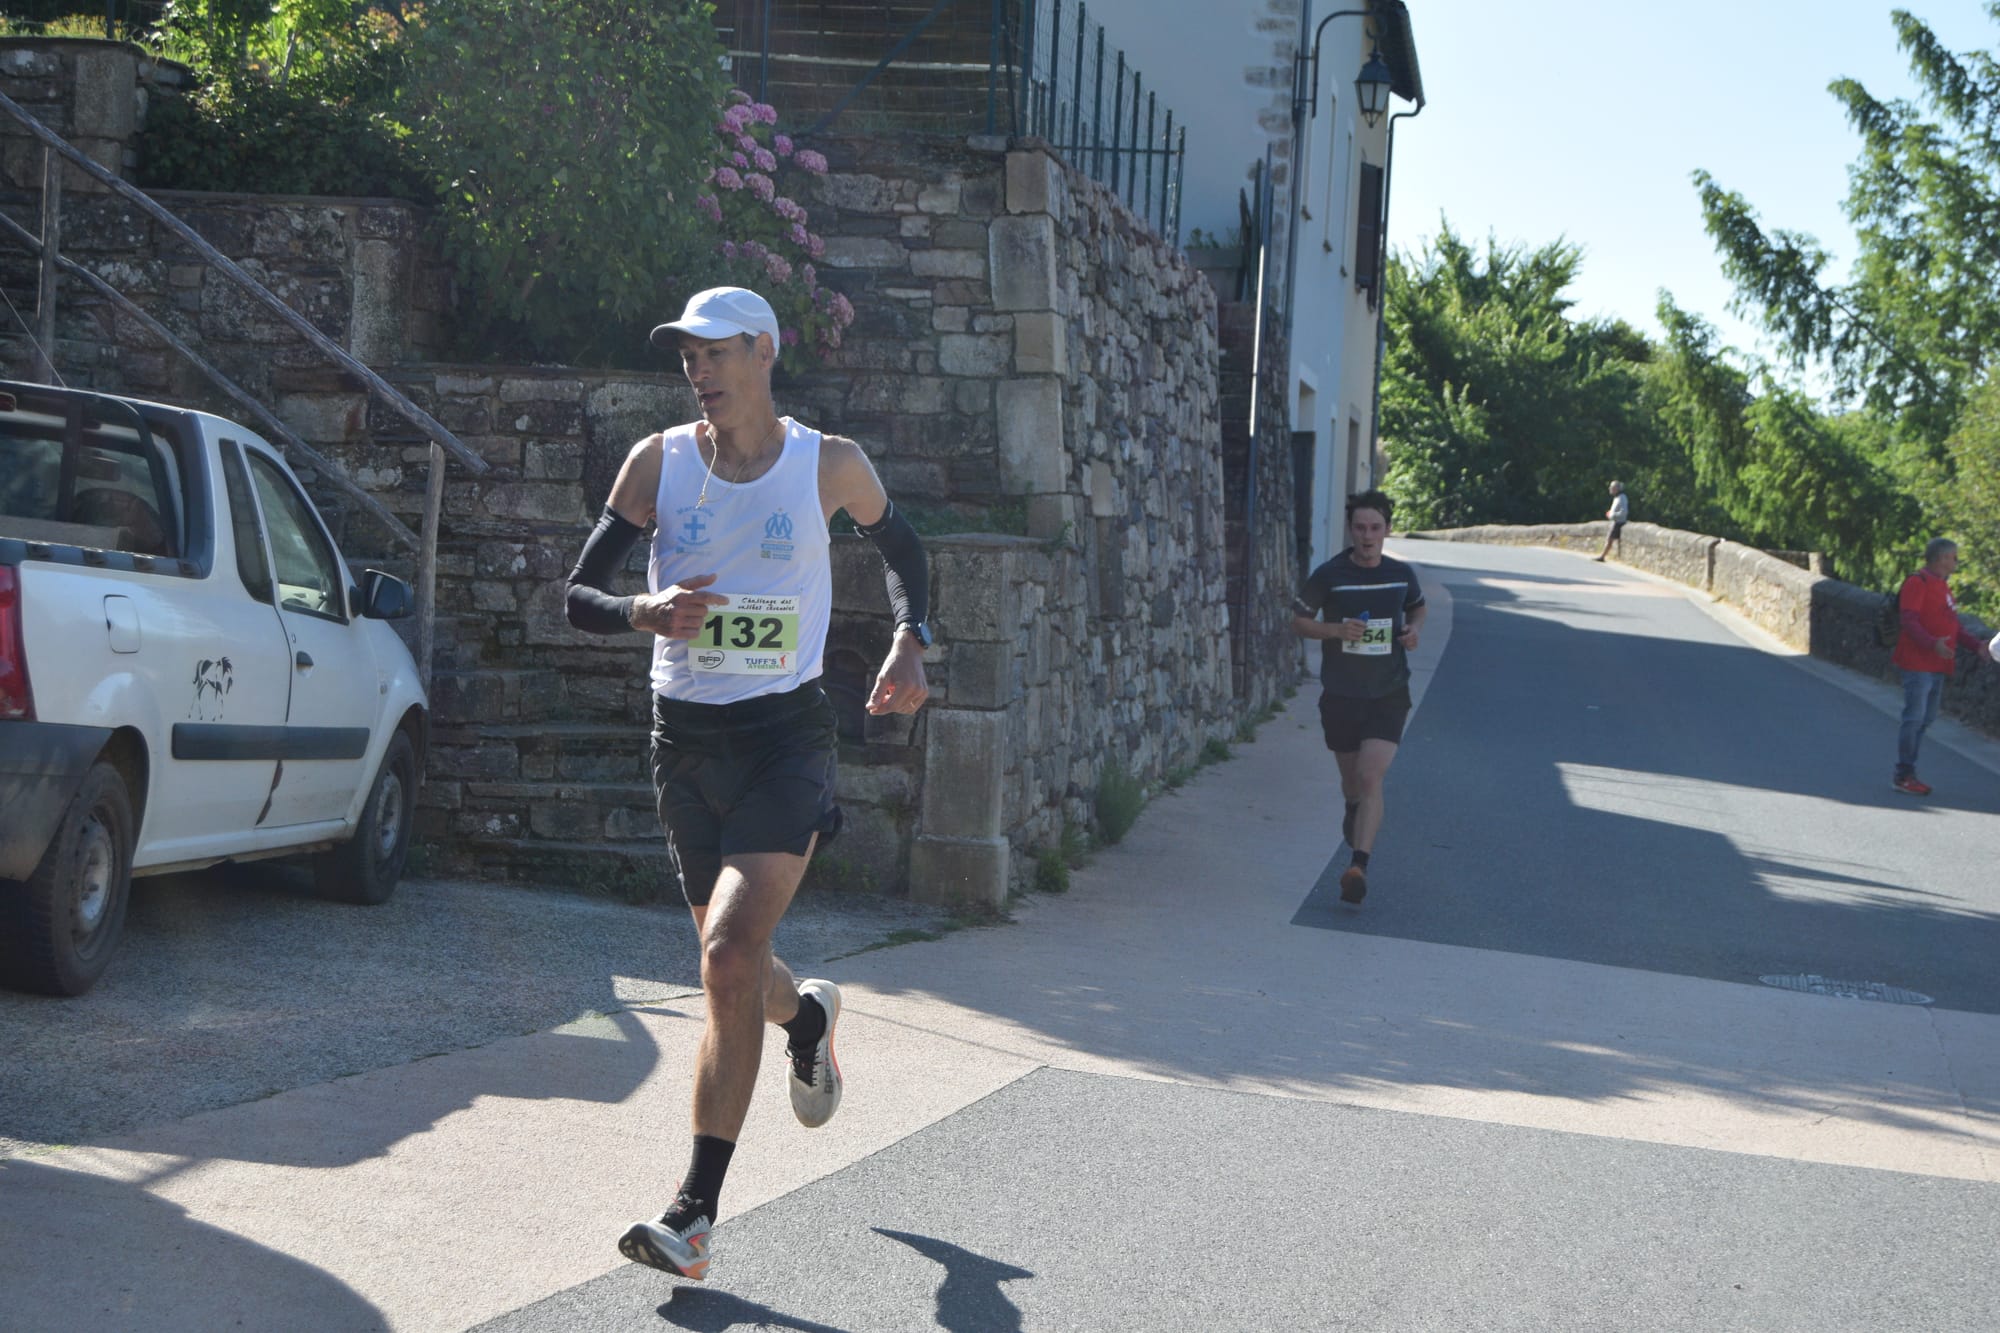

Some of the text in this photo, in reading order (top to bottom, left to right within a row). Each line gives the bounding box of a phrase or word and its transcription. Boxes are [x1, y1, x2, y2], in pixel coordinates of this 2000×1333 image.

[742, 597, 777, 607] Challenge
[705, 615, 783, 649] 132
[1362, 628, 1386, 643] 54
[744, 657, 777, 665] TUFF'S
